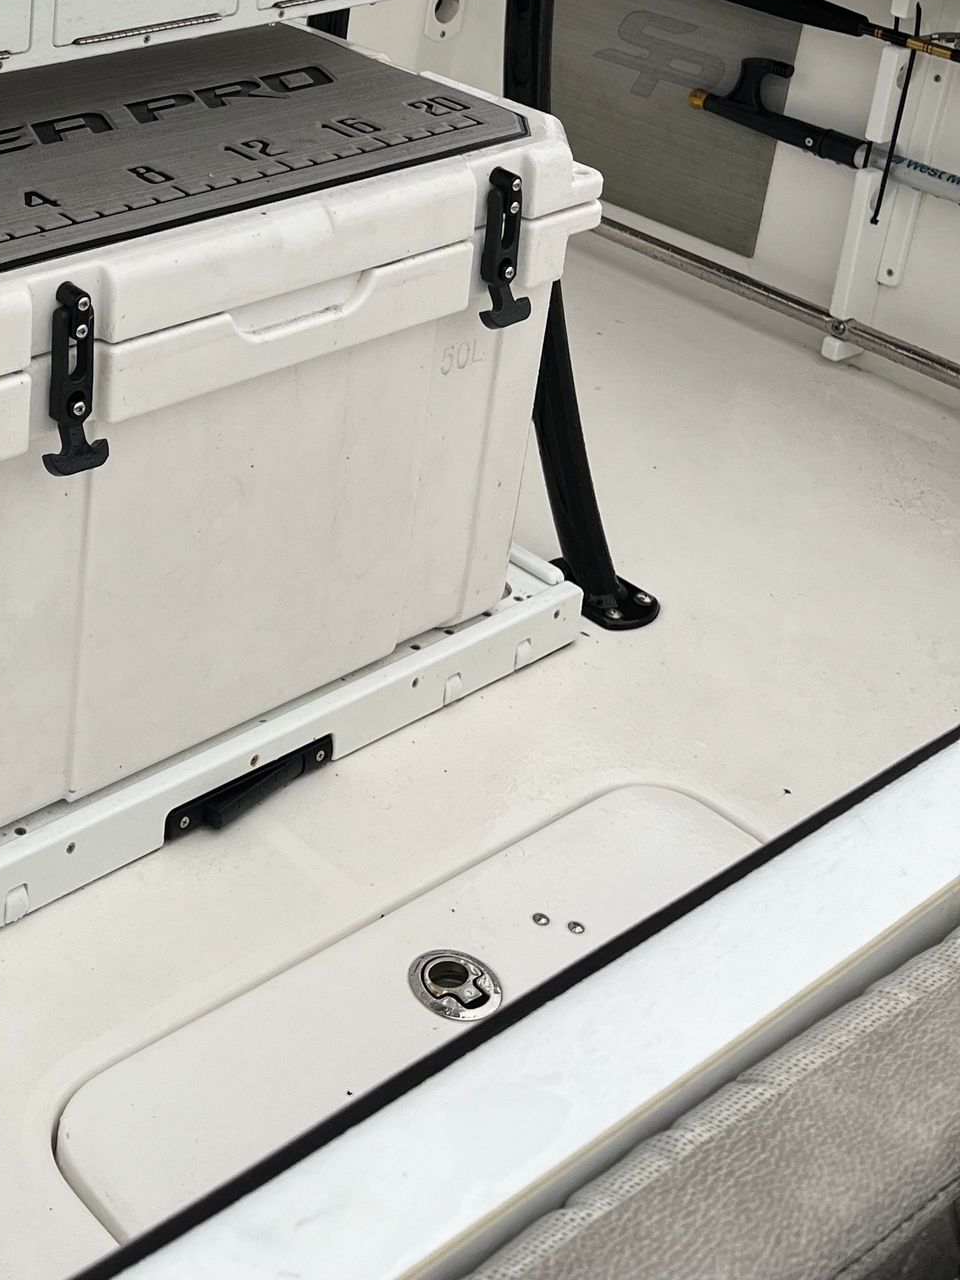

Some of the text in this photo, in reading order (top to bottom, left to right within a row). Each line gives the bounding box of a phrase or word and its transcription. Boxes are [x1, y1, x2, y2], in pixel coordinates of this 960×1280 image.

[123, 66, 335, 124] PRO
[24, 190, 62, 208] 4
[127, 166, 175, 185] 8
[224, 139, 289, 161] 12
[321, 117, 382, 140] 16
[406, 95, 472, 117] 20
[440, 338, 484, 375] 50L
